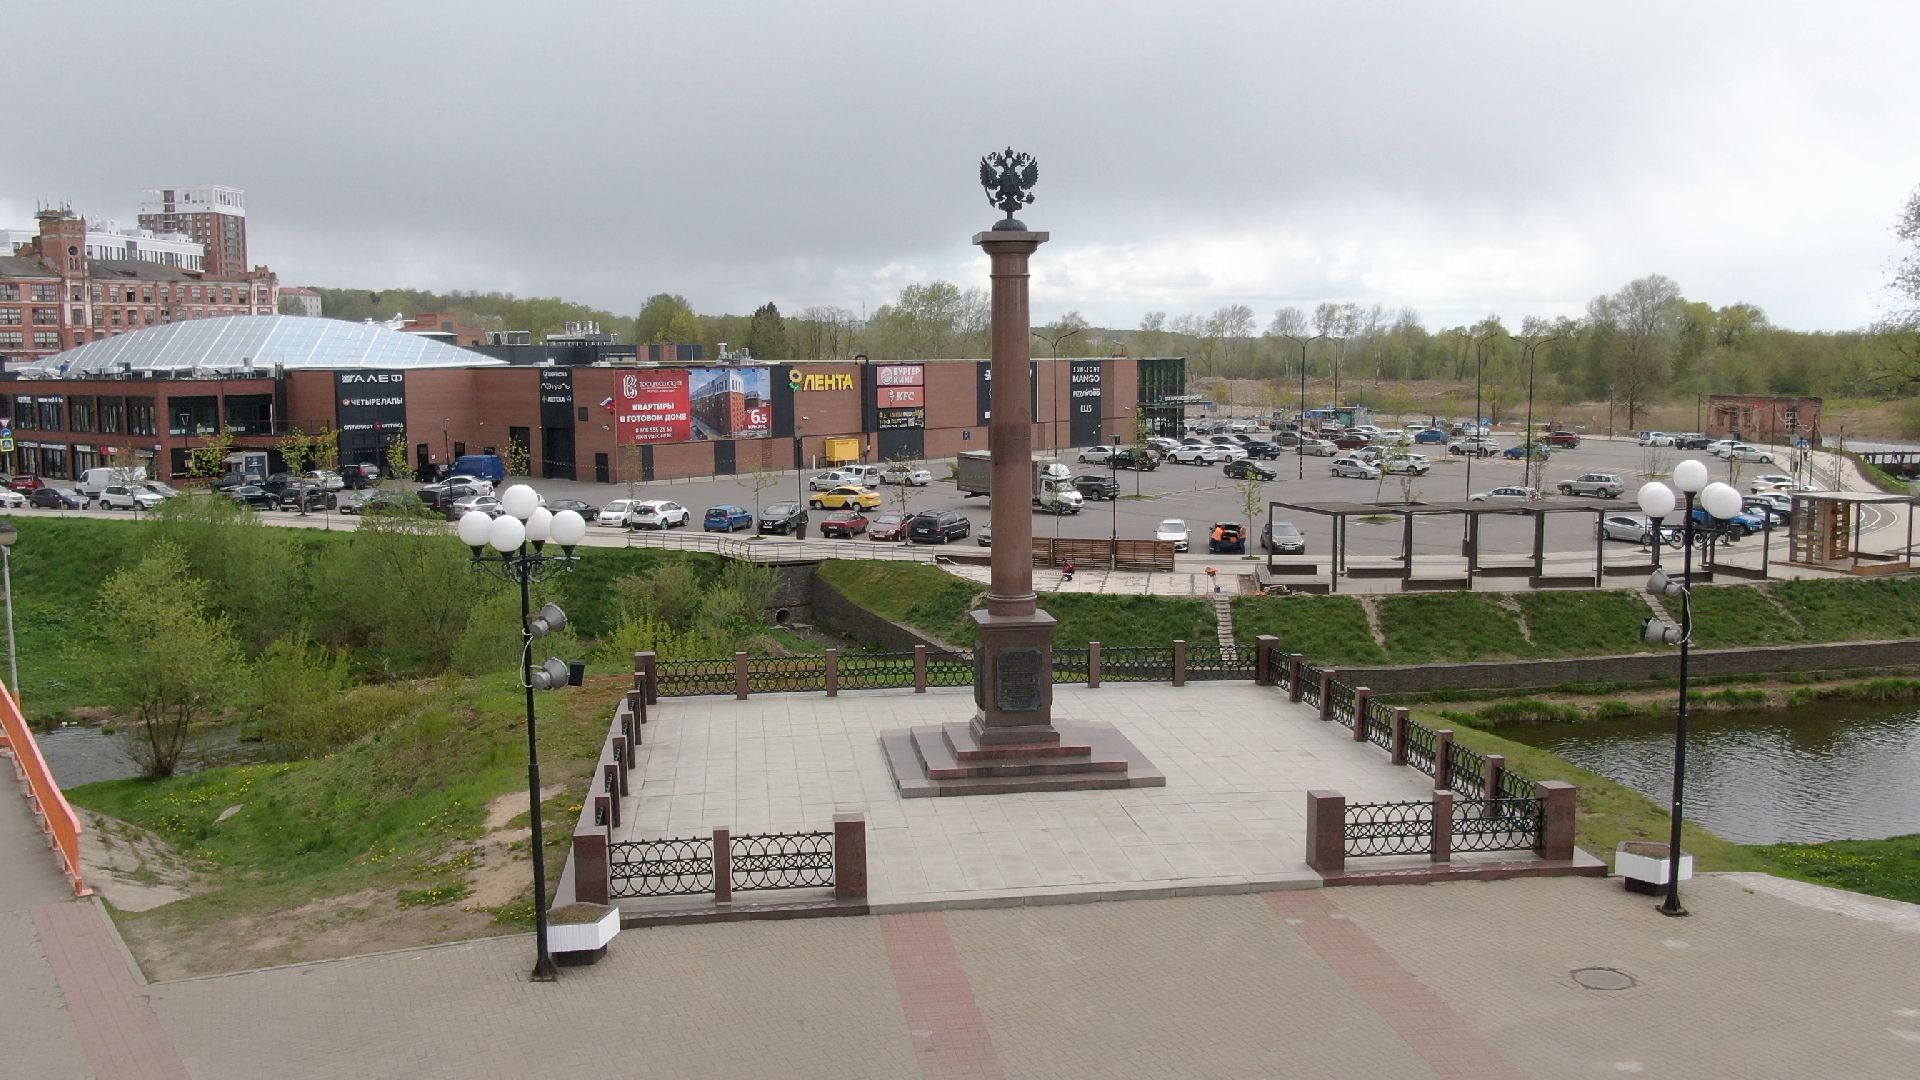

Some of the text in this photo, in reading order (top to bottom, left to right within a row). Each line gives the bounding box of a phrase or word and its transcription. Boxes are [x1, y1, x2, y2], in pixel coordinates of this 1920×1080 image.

[893, 367, 921, 376] БУРГЕР
[353, 374, 403, 383] АЛЕФ
[803, 374, 854, 391] ЛЕНТА
[893, 376, 913, 384] КИНГ
[1072, 375, 1100, 383] MANGO
[896, 391, 915, 401] KFC
[351, 397, 403, 406] ЧЕТЫРЕ ЛАПЫ
[632, 402, 675, 411] КВАРТИРЫ
[619, 413, 687, 423] В ГОТОВОМ ДОМЕ
